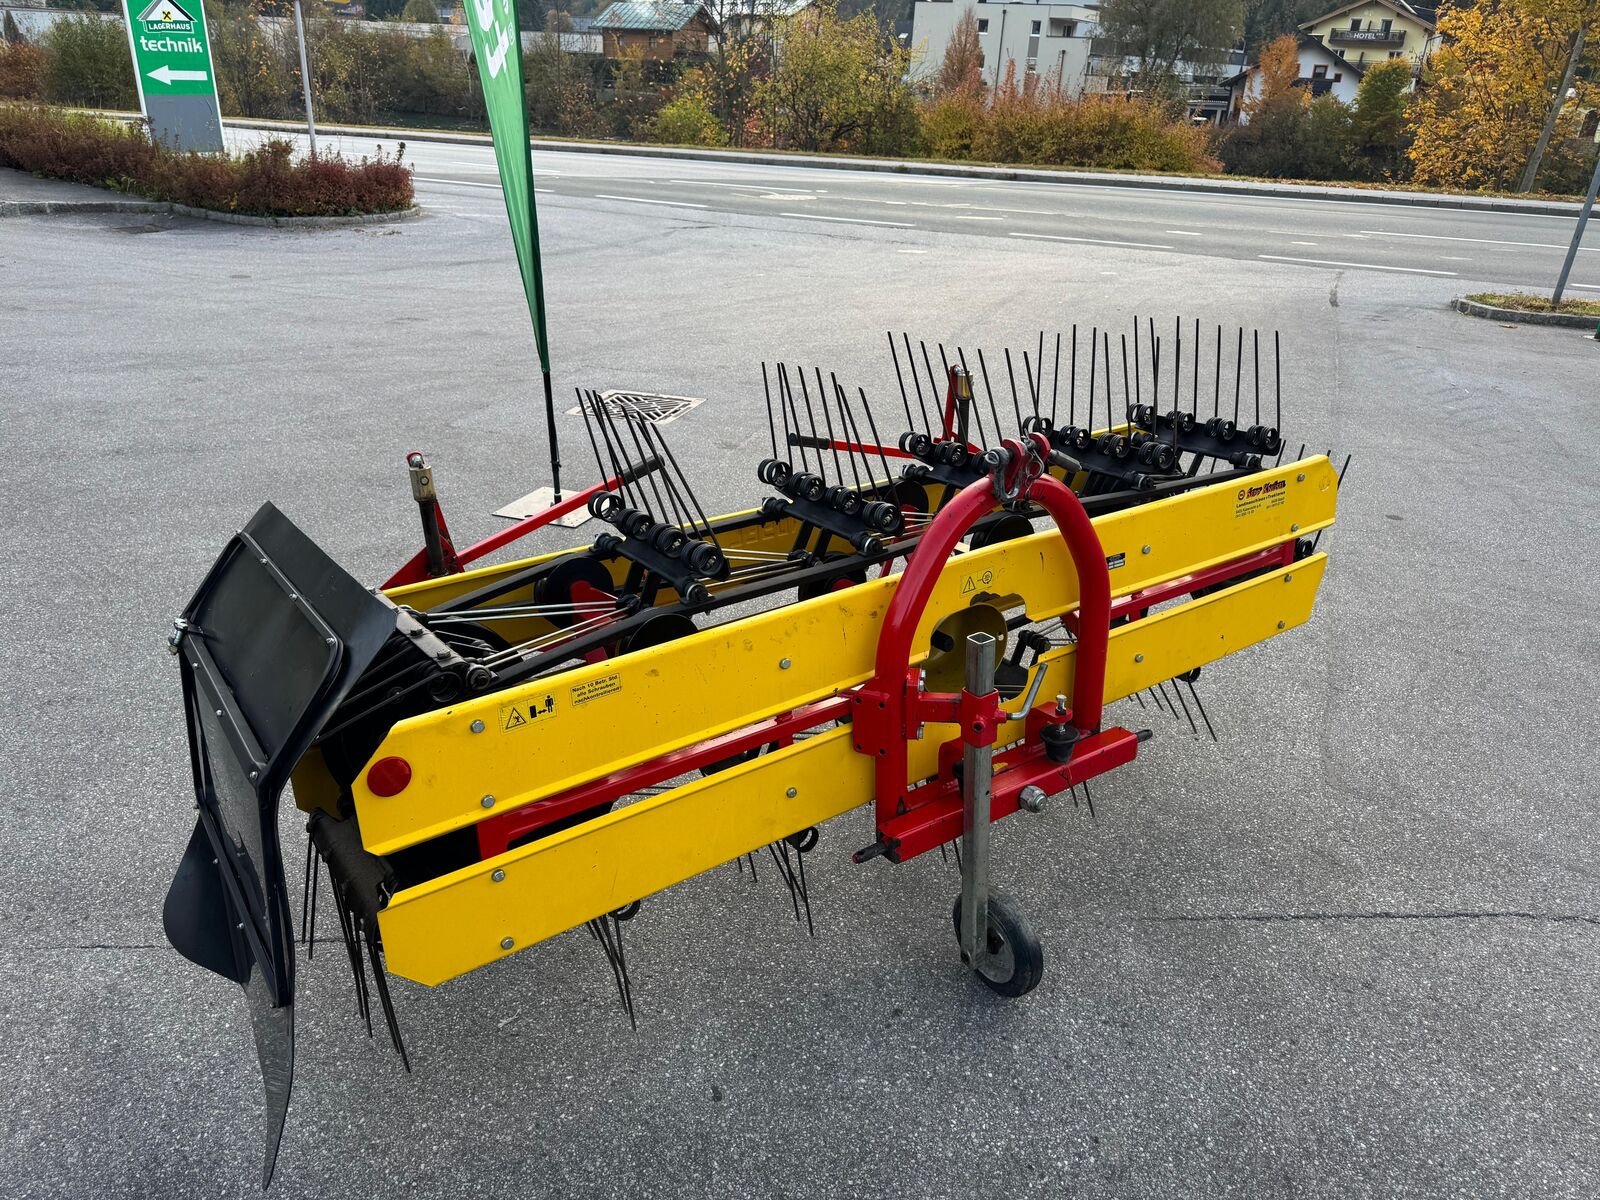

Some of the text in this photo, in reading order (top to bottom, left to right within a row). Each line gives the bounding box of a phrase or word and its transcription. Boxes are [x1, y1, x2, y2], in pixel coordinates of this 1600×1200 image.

[148, 22, 191, 31] LAGERHAUS
[1353, 32, 1377, 40] HOTEL
[140, 35, 203, 53] technik
[572, 685, 586, 693] Nach
[587, 682, 616, 694] Schrauben
